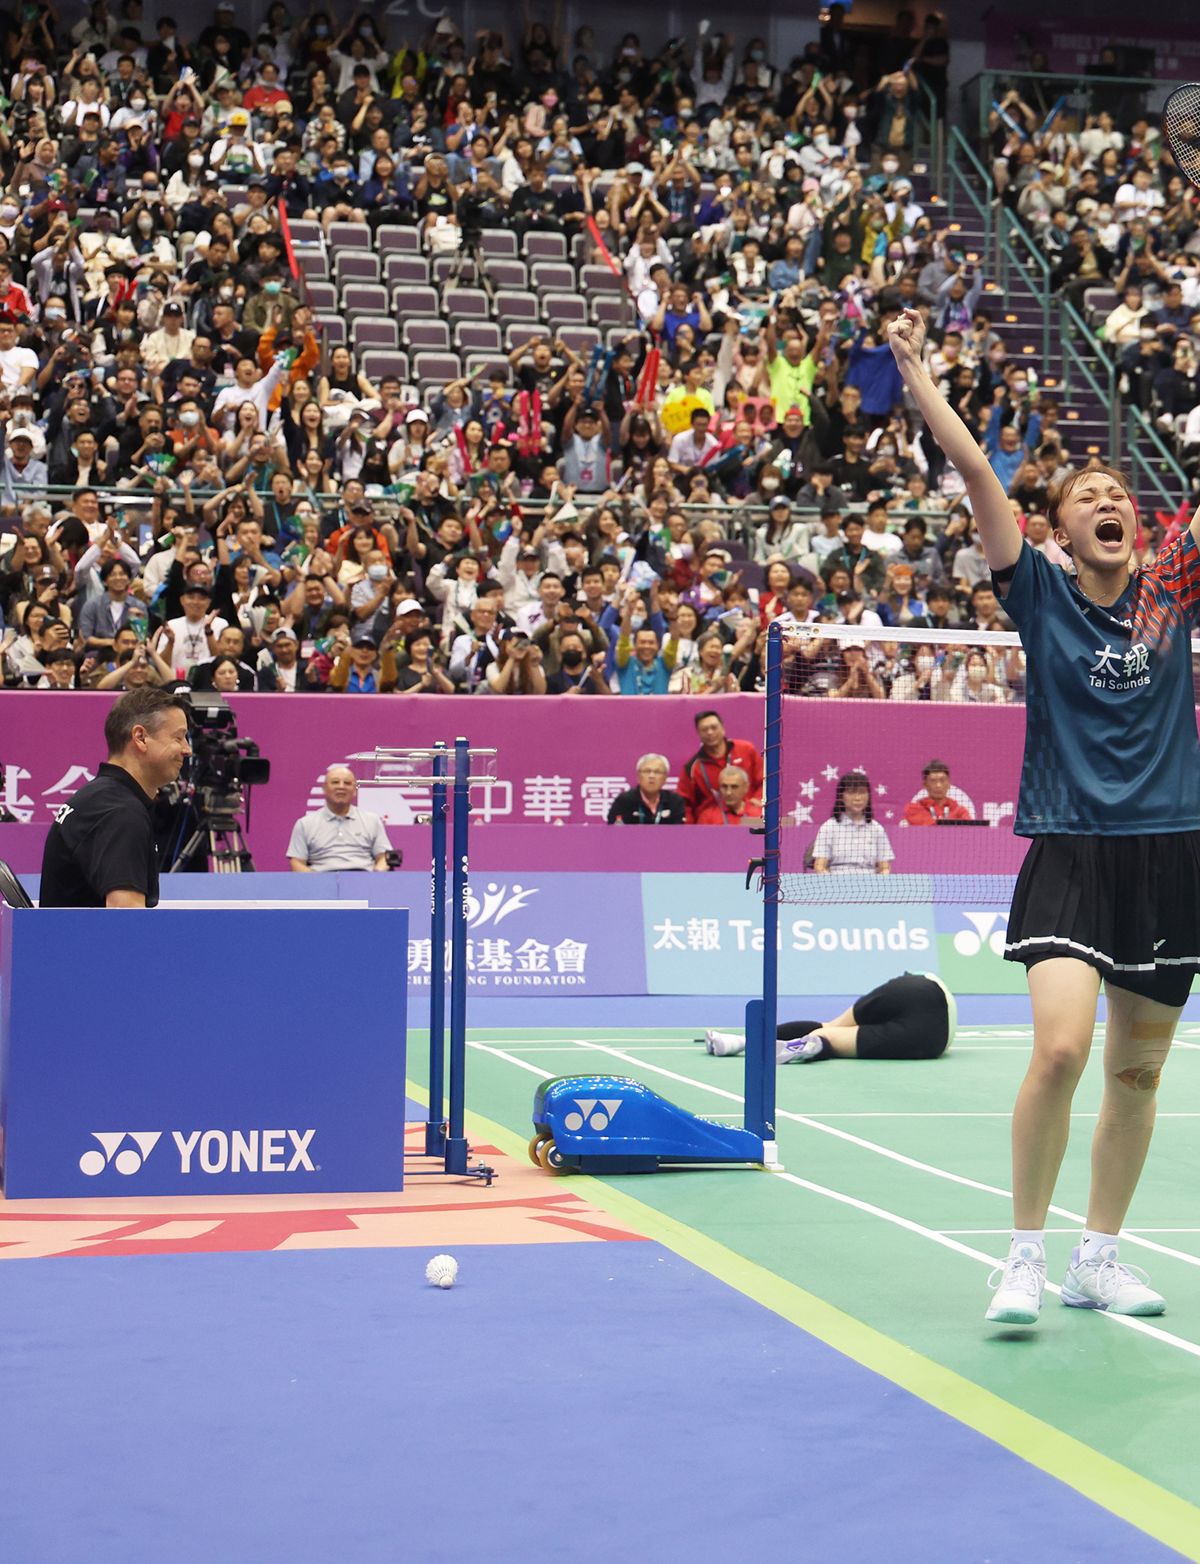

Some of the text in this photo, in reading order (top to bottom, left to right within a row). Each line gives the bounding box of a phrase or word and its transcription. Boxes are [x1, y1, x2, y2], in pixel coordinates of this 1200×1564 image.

[1090, 642, 1151, 679] 太報
[1088, 675, 1152, 691] Tai Sounds
[653, 917, 722, 951] 太報
[791, 920, 930, 952] Sounds
[494, 975, 587, 986] FOUNDATION
[172, 1128, 317, 1174] YONEX
